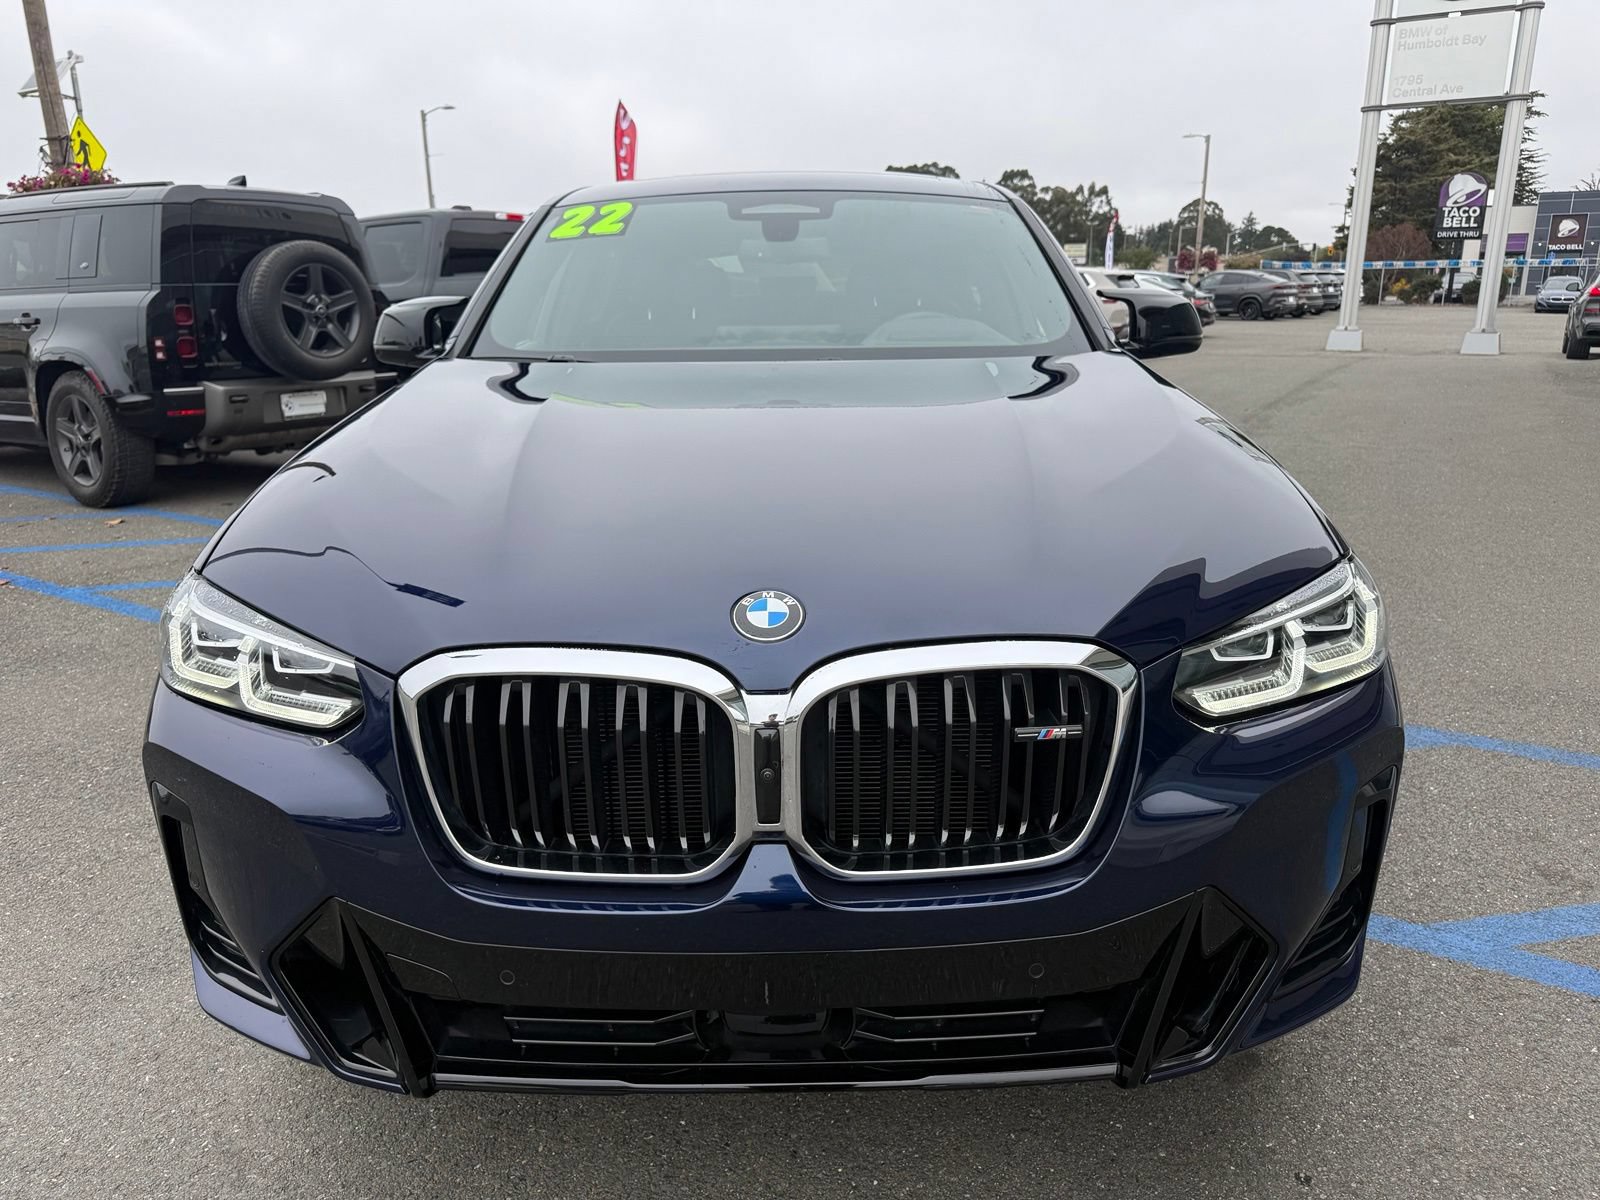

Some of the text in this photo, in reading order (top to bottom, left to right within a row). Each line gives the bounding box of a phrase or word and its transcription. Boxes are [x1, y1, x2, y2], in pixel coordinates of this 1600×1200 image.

[1400, 24, 1448, 39] BMW of
[1397, 34, 1487, 50] Humboldt Bay
[1392, 84, 1464, 98] Central Ave
[1442, 207, 1480, 217] TACO
[549, 202, 633, 240] 22
[1442, 217, 1478, 228] BELL
[741, 592, 796, 606] BMW
